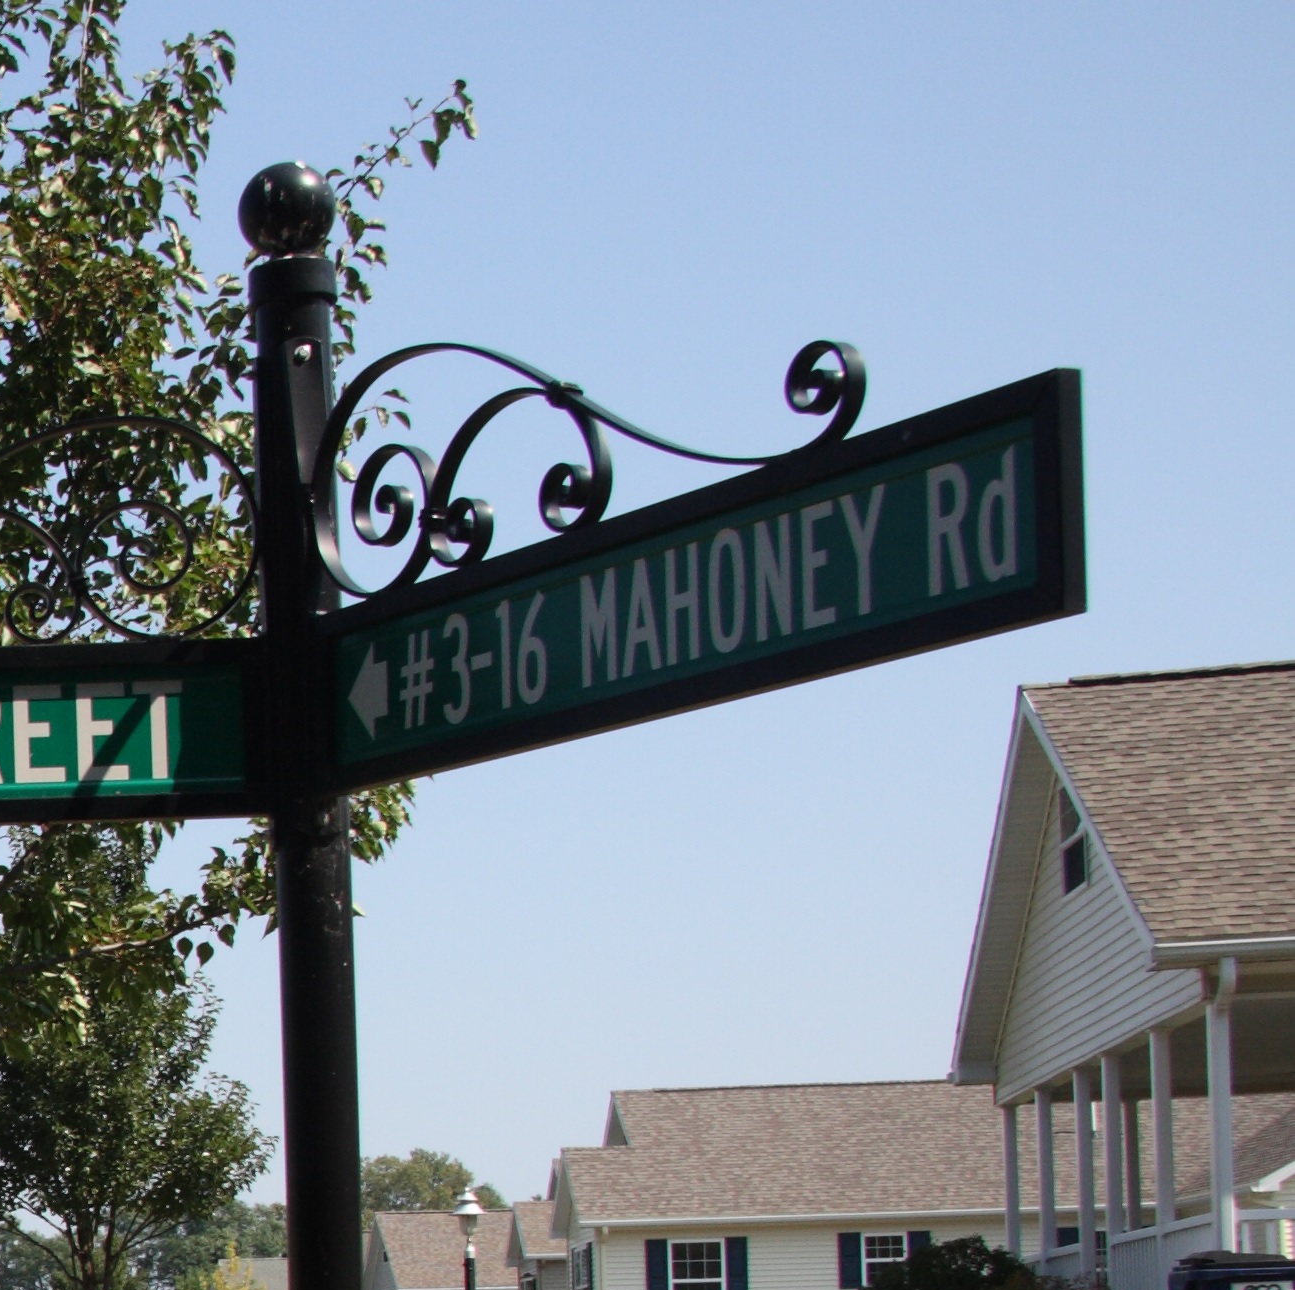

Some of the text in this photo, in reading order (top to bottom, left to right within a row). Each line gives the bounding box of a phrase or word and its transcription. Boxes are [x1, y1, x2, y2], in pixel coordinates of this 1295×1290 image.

[399, 442, 1019, 730] #3-16 MAHONEY Rd
